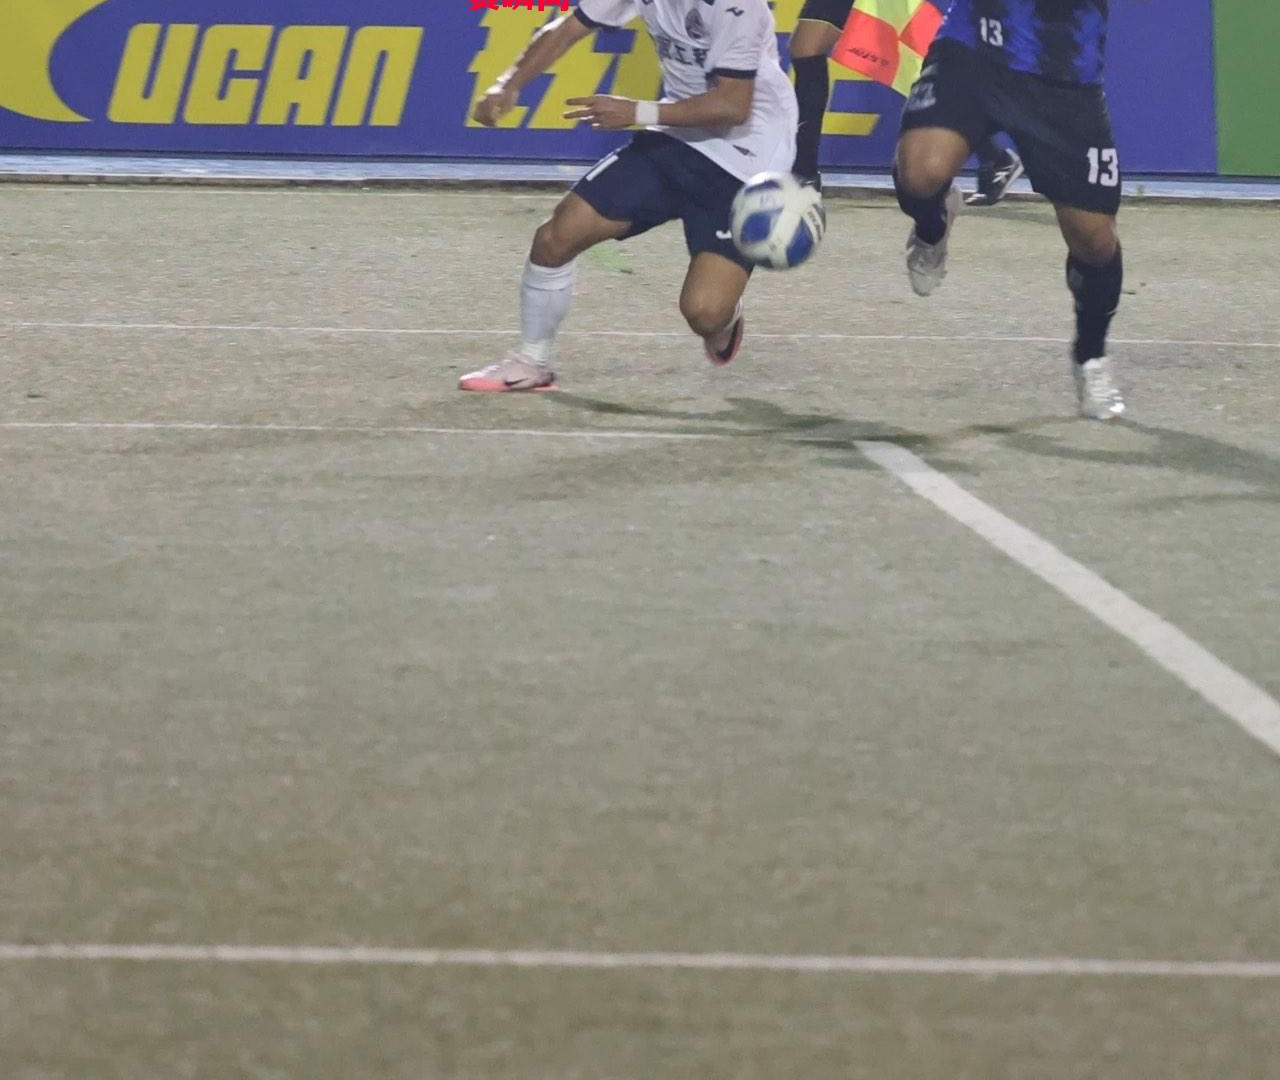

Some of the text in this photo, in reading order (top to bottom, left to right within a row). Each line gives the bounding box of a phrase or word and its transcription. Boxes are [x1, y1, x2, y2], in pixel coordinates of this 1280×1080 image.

[980, 16, 1003, 47] 13
[106, 22, 424, 126] UCAN
[1086, 147, 1119, 187] 13
